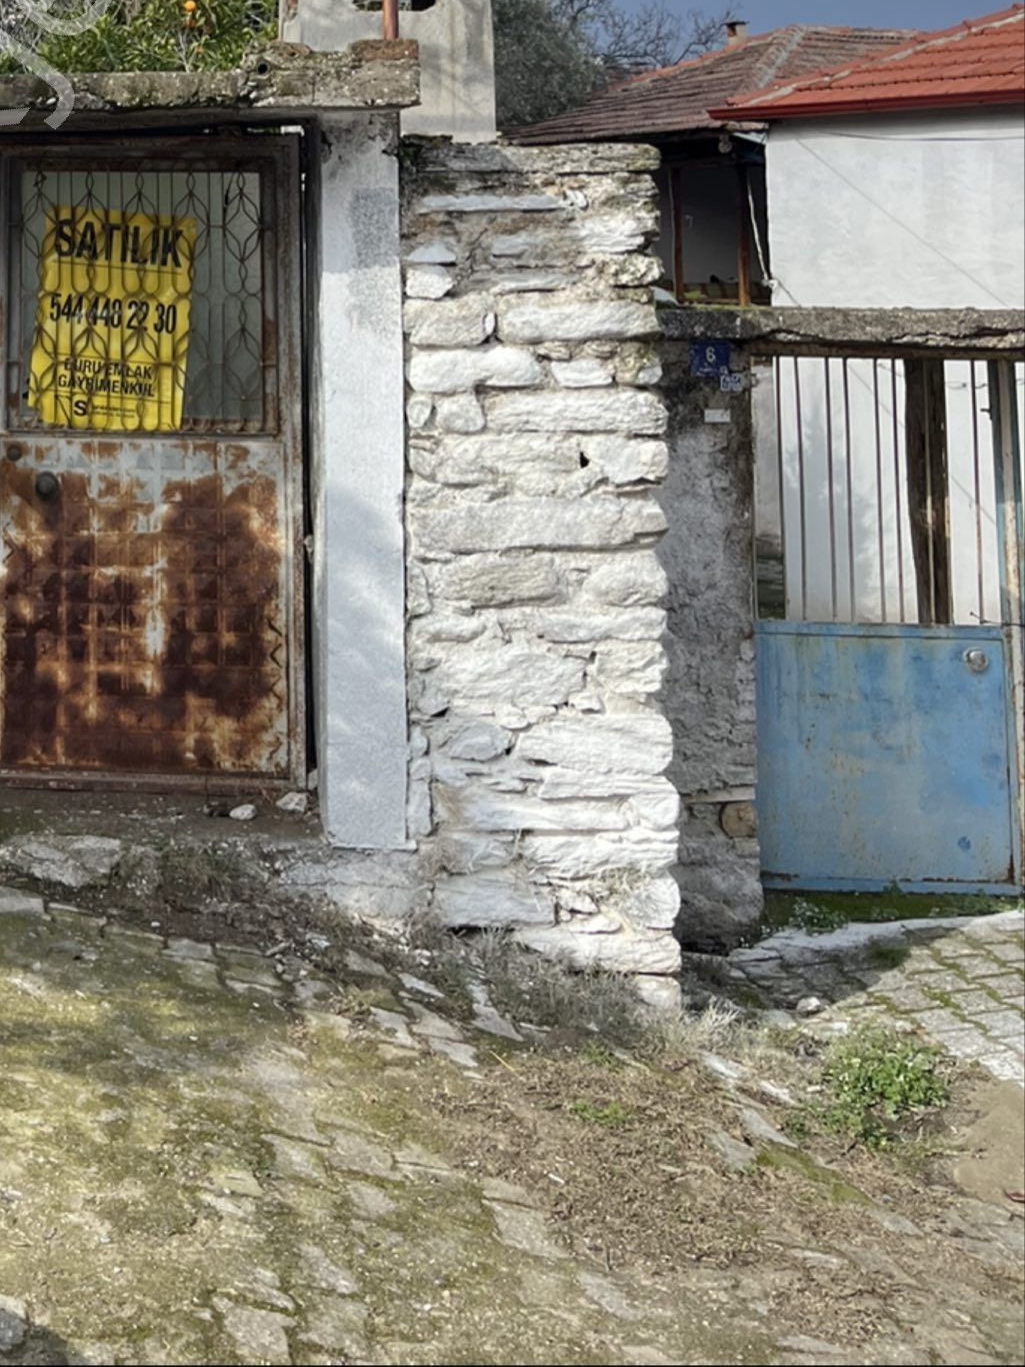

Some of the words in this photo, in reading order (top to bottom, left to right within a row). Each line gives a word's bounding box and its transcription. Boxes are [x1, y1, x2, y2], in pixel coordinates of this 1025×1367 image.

[55, 218, 183, 267] SATILIK
[50, 293, 84, 324] 544
[126, 300, 150, 332] 22
[154, 302, 177, 335] 30
[107, 361, 153, 380] EMLAK
[74, 399, 88, 417] S
